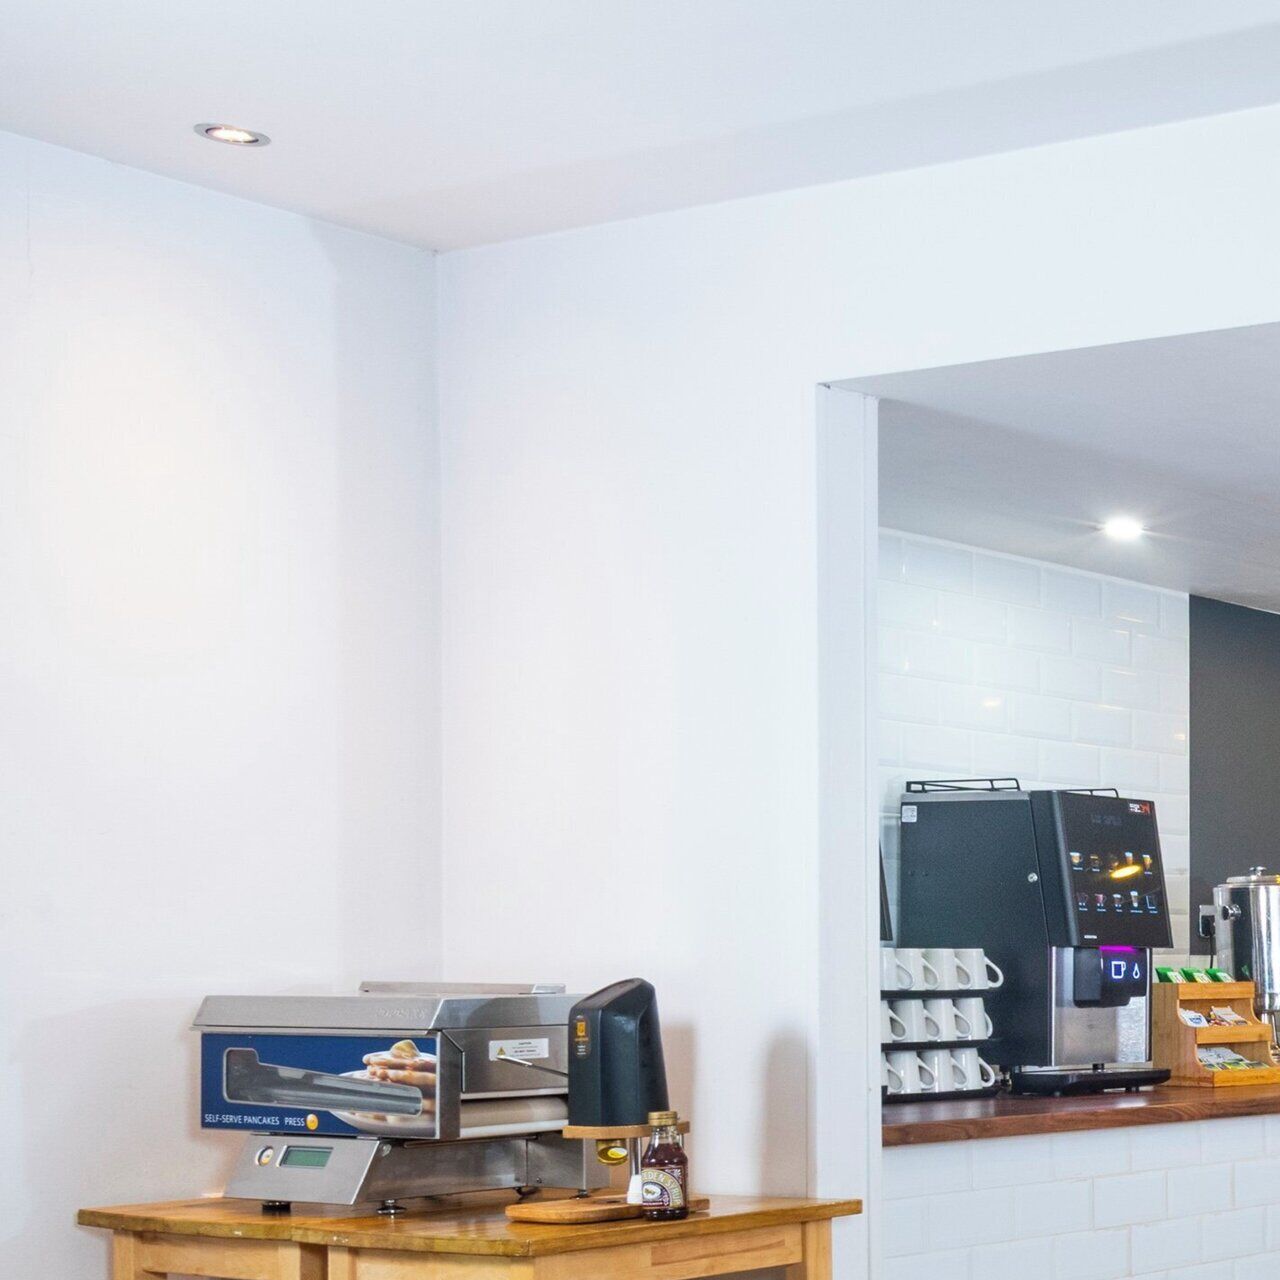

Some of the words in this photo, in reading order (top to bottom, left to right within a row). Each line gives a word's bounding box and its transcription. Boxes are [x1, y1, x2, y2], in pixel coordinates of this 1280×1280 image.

[204, 1113, 242, 1125] SELF-SERVE
[243, 1115, 280, 1126] PANCAKES
[284, 1117, 306, 1127] PRESS
